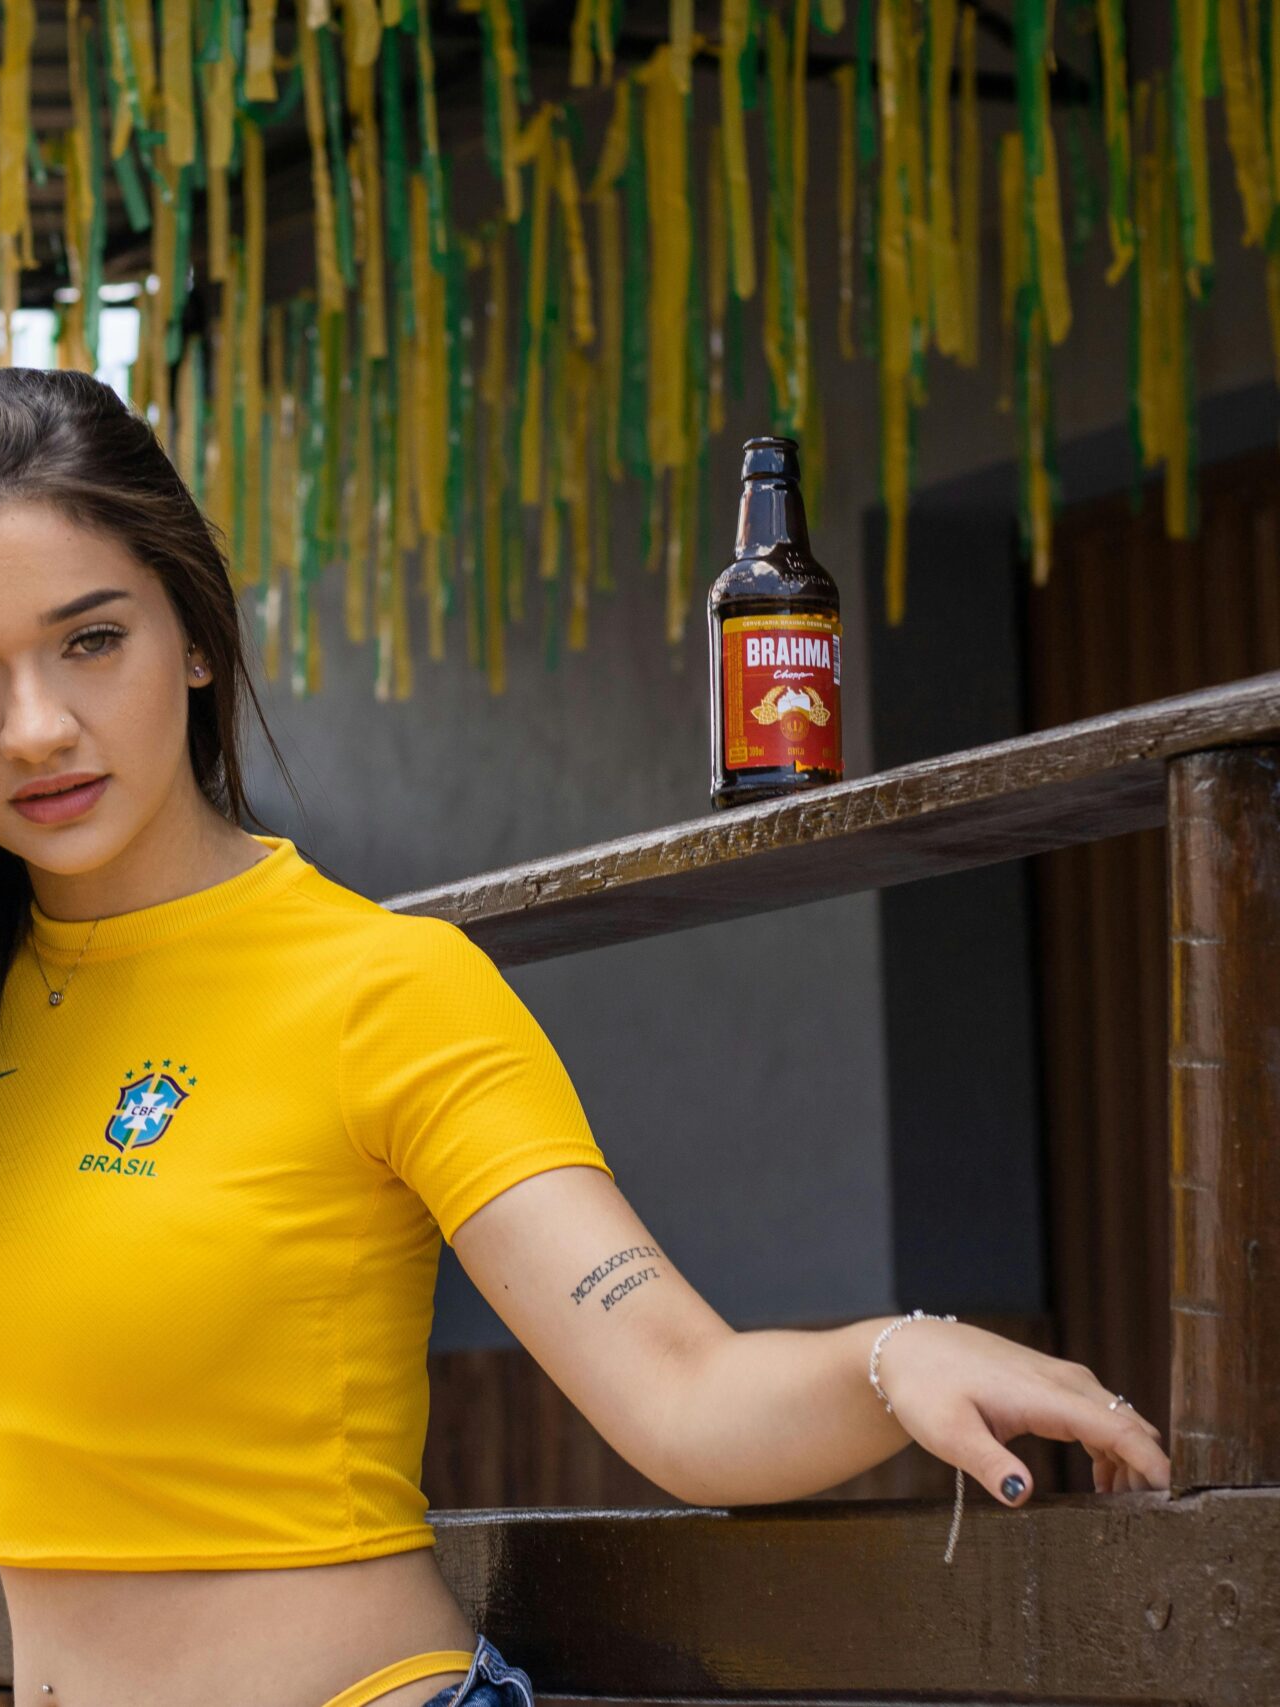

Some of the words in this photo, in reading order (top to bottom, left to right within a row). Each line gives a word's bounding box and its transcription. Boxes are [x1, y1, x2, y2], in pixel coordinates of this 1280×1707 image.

[746, 636, 831, 669] BRAHMA
[130, 1106, 158, 1117] CBF
[78, 1154, 158, 1177] BRASIL
[601, 1267, 660, 1312] MCMLVI
